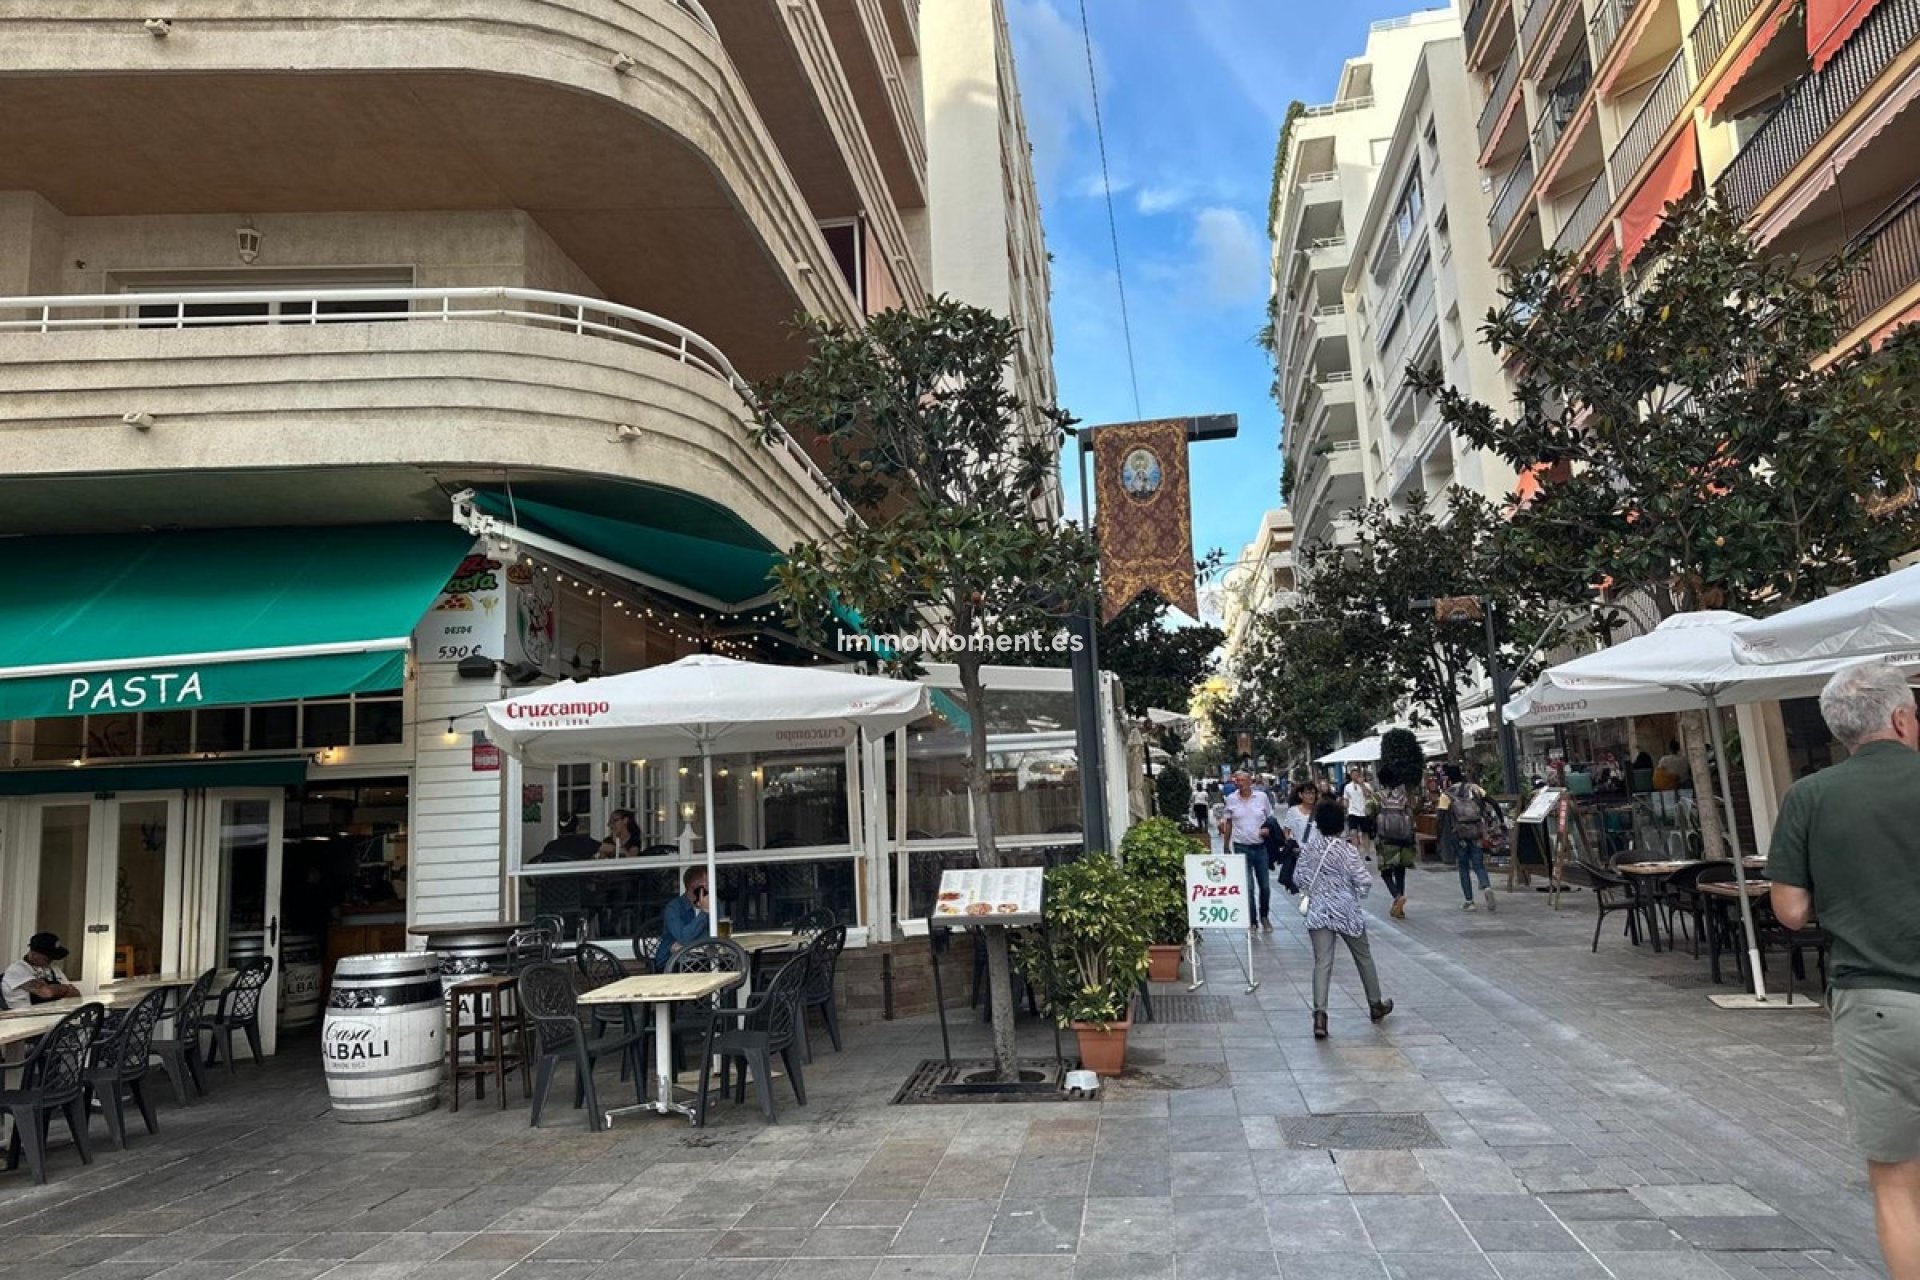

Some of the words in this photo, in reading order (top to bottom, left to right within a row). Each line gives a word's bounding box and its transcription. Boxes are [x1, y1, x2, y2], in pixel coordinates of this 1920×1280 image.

[442, 571, 499, 593] asta
[67, 671, 203, 710] PASTA
[506, 701, 609, 719] Cruzcampo
[1192, 885, 1240, 901] Pizza
